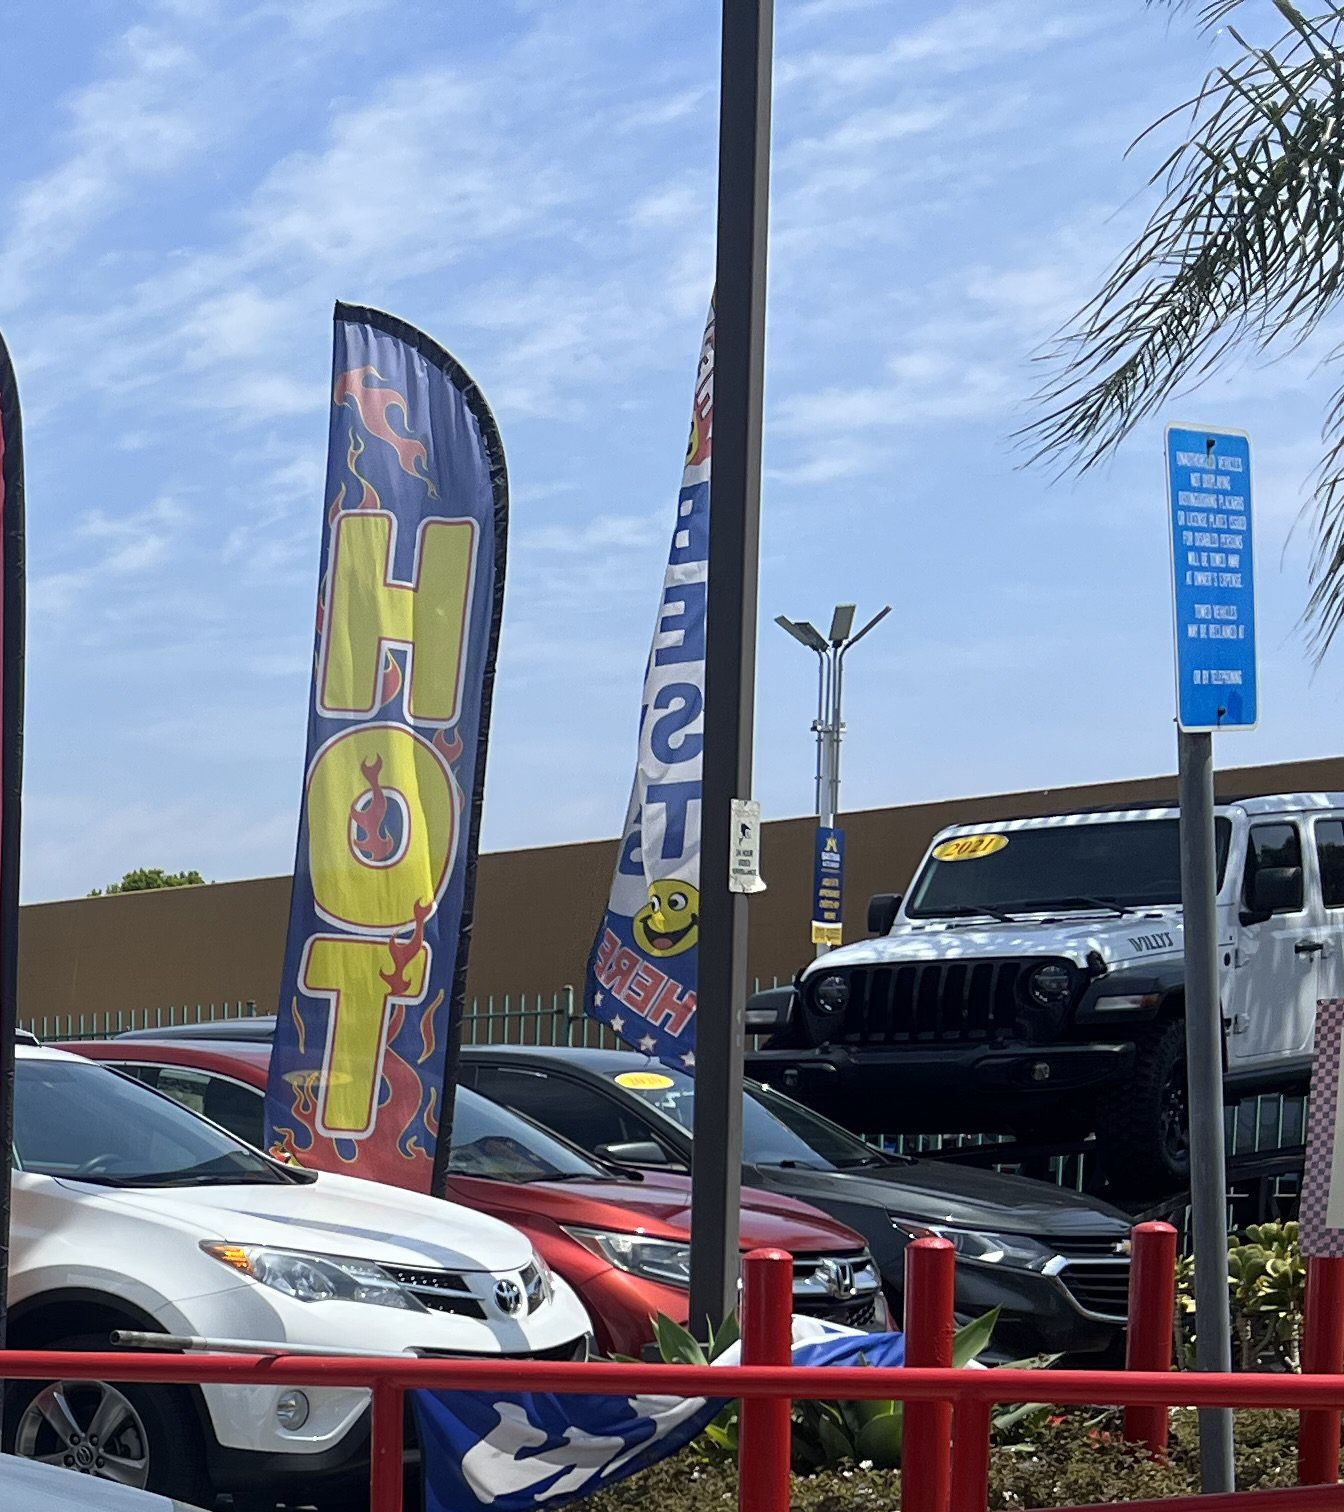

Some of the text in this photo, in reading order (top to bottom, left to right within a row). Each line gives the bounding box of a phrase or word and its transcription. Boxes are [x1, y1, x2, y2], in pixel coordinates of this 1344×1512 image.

[297, 509, 479, 1139] HOT
[943, 837, 996, 857] 2021
[1127, 931, 1174, 952] WILLYS
